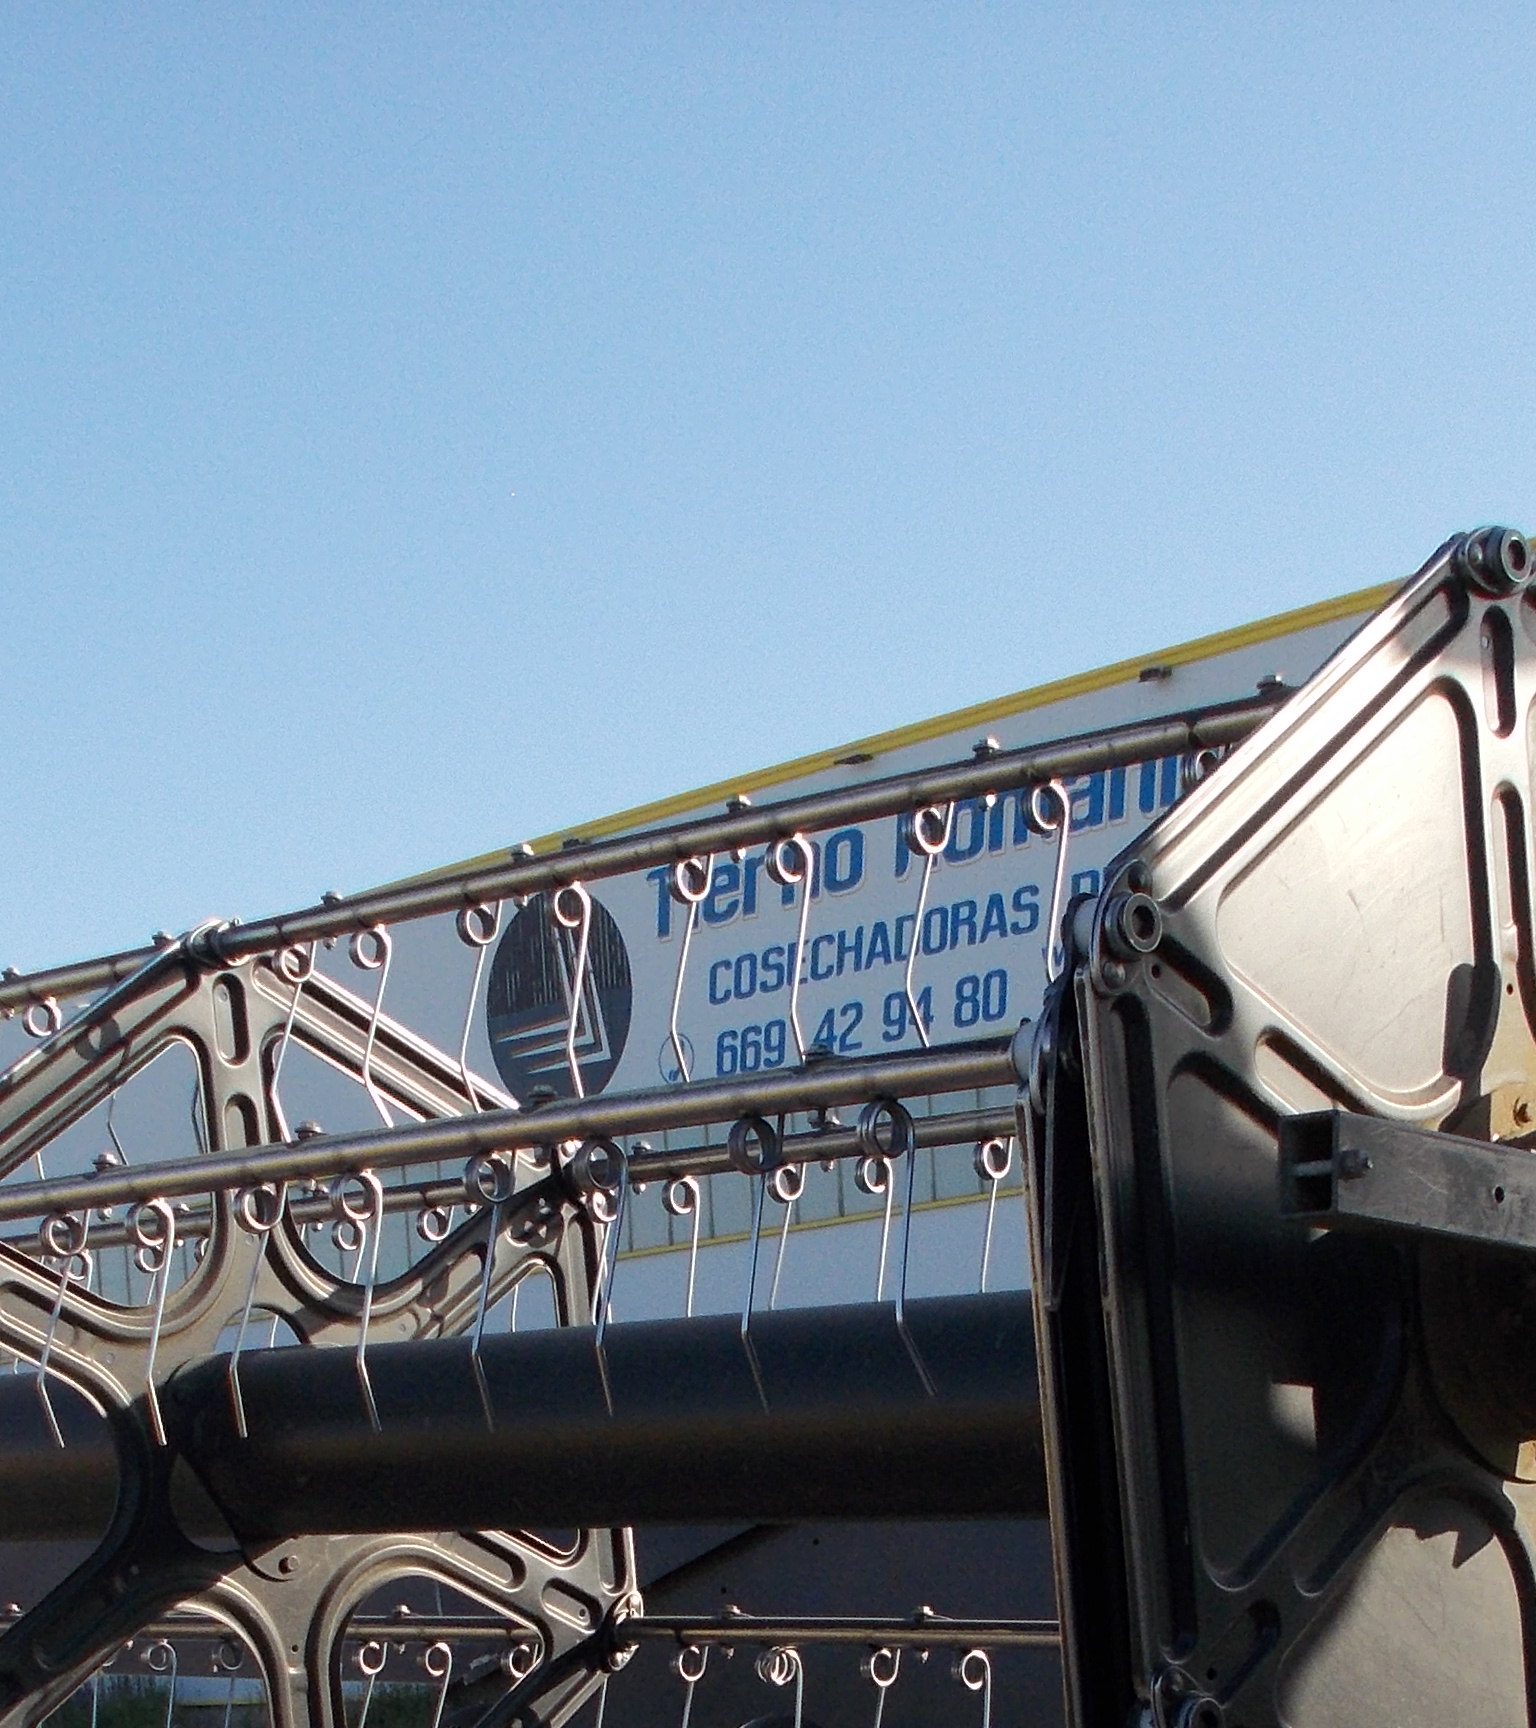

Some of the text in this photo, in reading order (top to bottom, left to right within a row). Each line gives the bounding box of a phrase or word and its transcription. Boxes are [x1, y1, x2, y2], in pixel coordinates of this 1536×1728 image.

[709, 884, 1040, 1006] COSECHADORAS
[716, 969, 1007, 1077] 669 42 94 80
